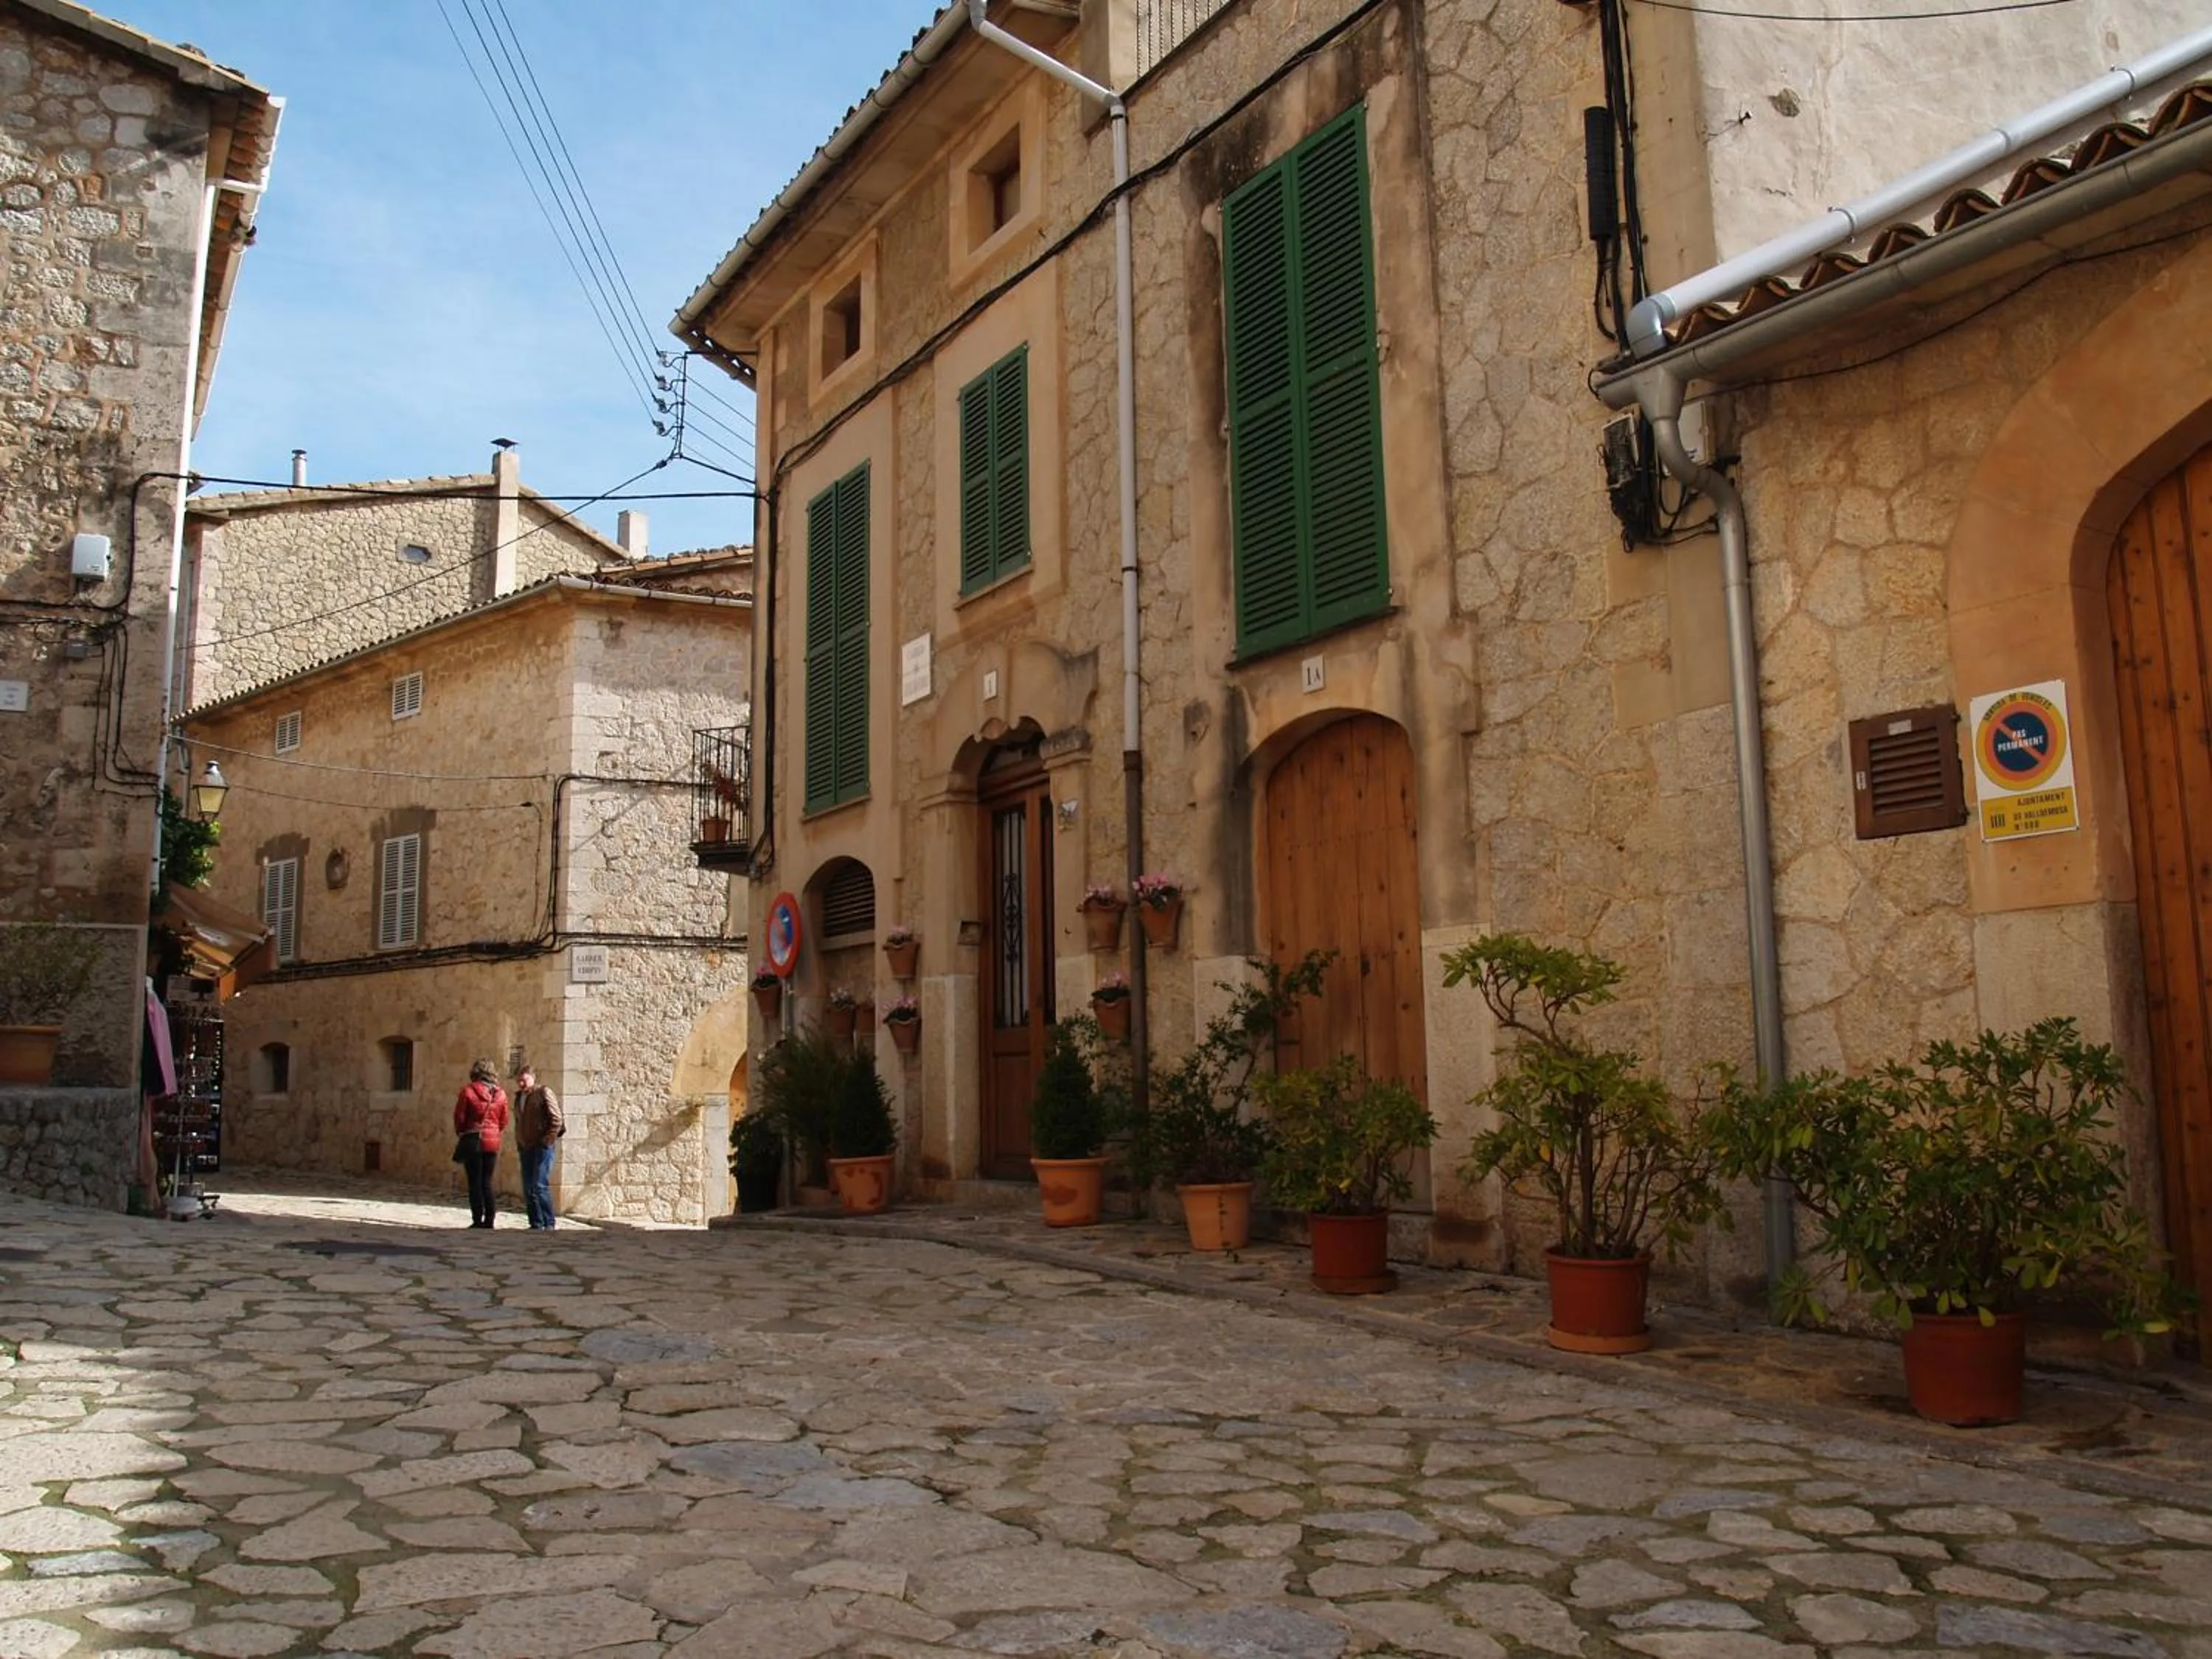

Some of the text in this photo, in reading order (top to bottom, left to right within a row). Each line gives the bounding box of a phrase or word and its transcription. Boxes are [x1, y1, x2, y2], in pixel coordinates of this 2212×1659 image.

[2011, 728, 2026, 739] PAS
[1997, 735, 2044, 752] PERMANENT
[2017, 793, 2065, 807] AJUNTAMENT
